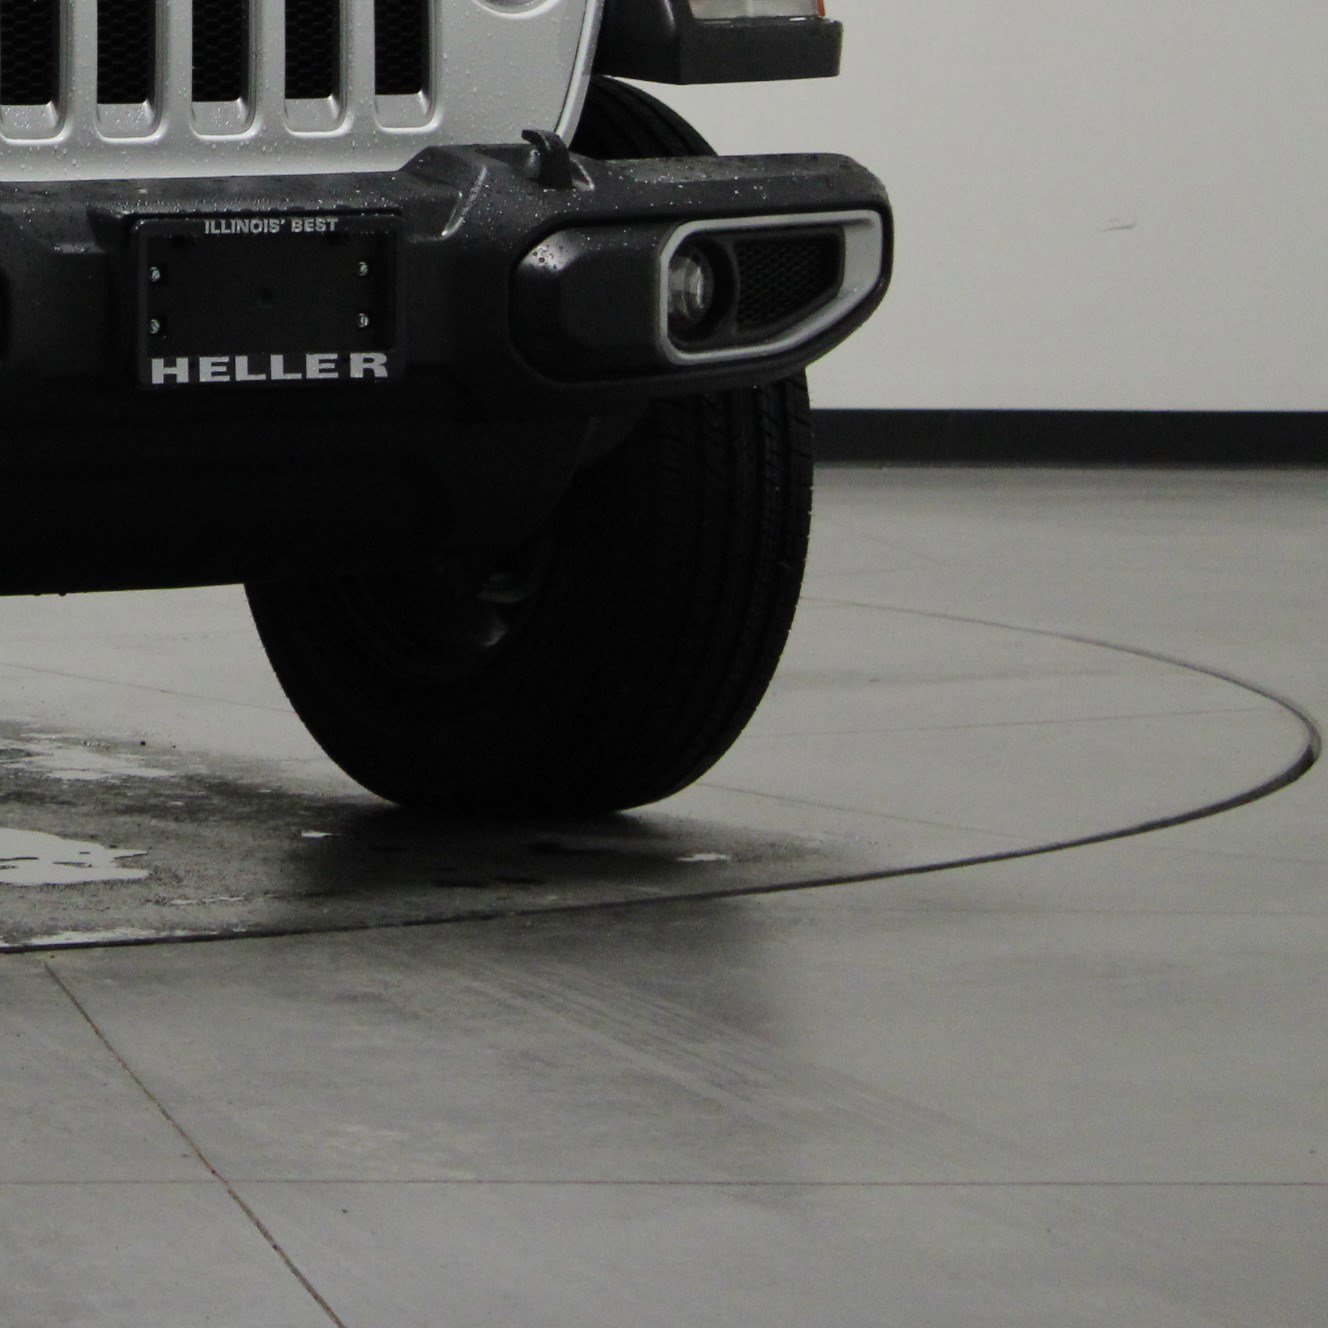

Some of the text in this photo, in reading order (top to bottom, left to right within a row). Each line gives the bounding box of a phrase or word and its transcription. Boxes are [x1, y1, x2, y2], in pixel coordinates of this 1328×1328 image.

[205, 217, 339, 234] ILLINOIS' BEST
[150, 352, 389, 385] HELLER
